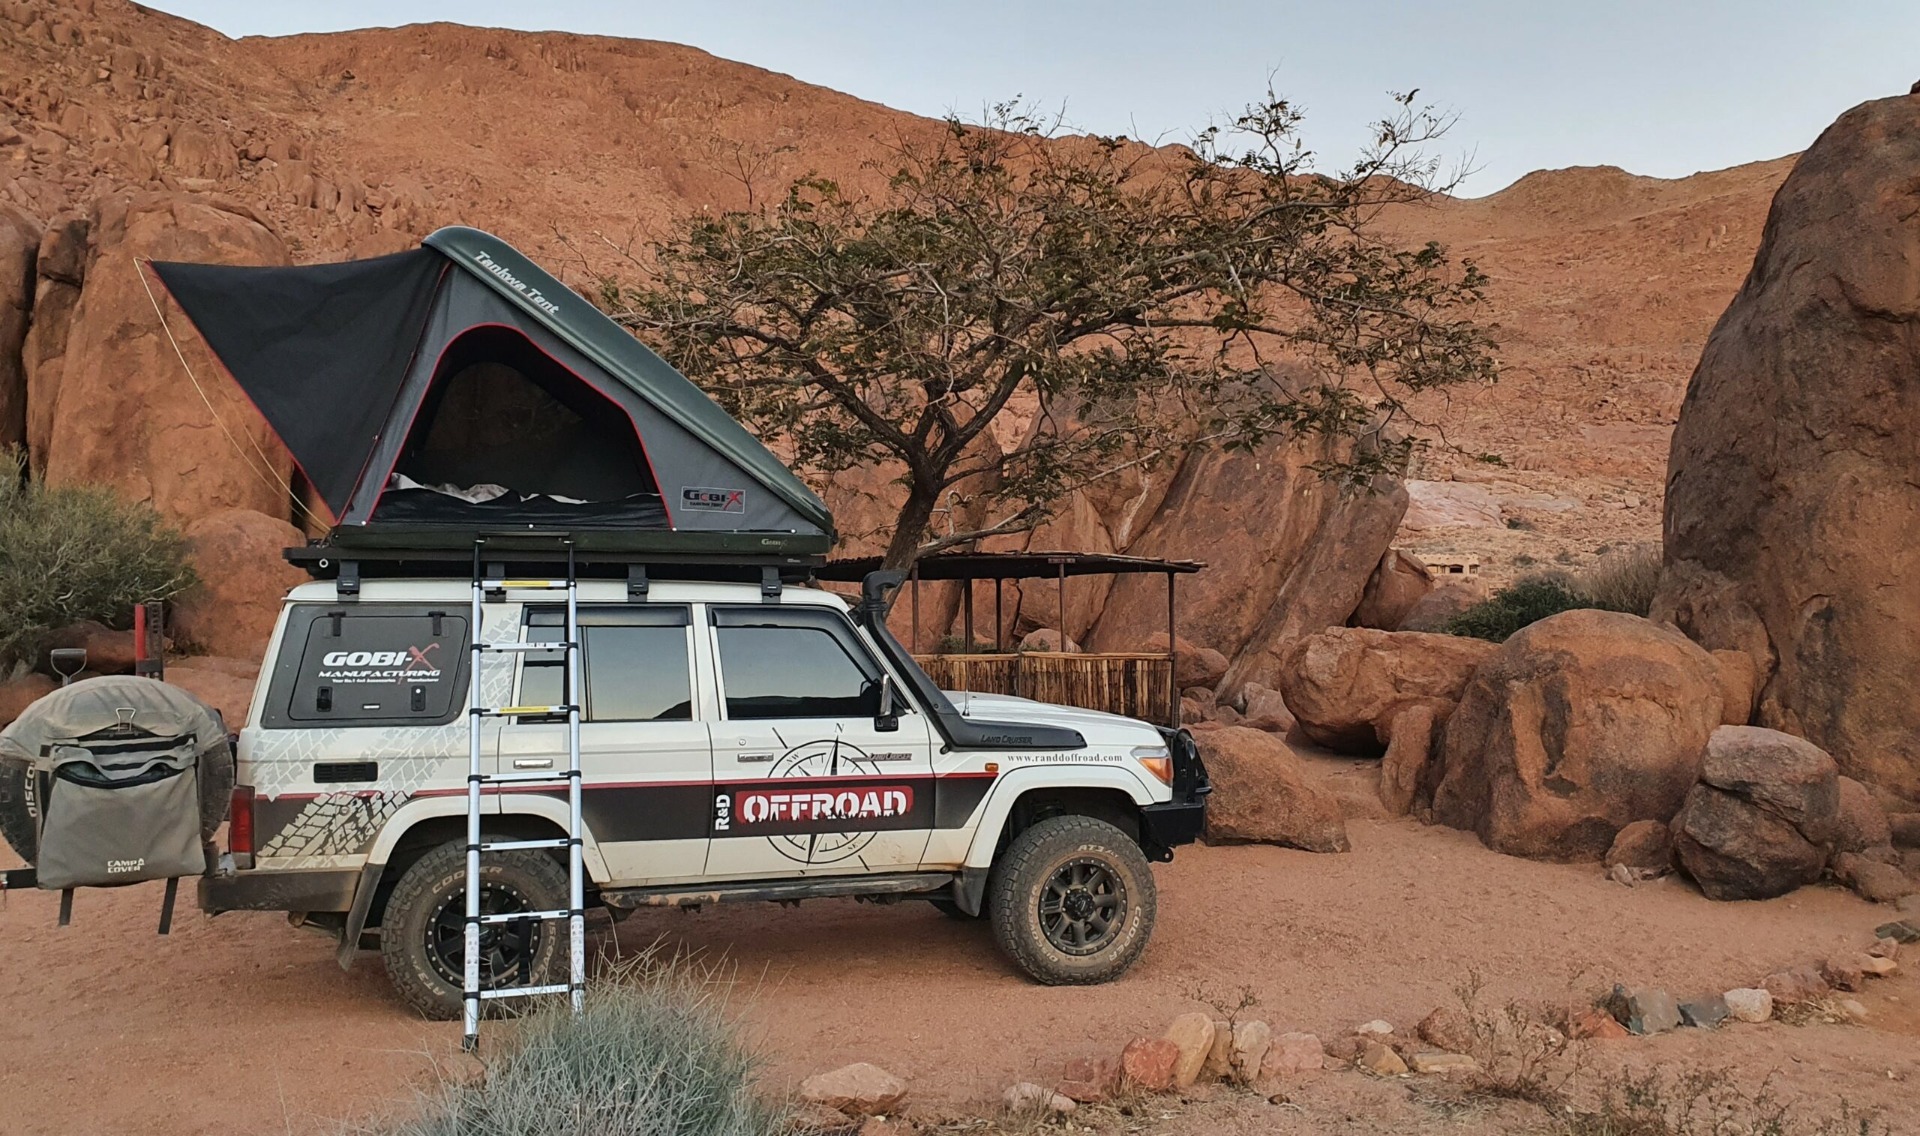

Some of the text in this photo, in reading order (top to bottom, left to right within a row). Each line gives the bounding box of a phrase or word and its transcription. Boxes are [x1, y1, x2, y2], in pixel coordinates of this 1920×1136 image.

[474, 250, 560, 314] Tankwa Tent
[322, 643, 440, 672] GOBI-X
[318, 669, 441, 678] MANUFACTURING
[834, 722, 844, 733] N
[1007, 753, 1123, 763] www.randdoffroad.com
[24, 762, 38, 818] DISCO
[715, 794, 731, 831] R&D
[743, 790, 907, 823] OFFROAD
[107, 859, 138, 867] CAMP
[432, 866, 503, 894] COOER
[1108, 905, 1142, 962] COOPER
